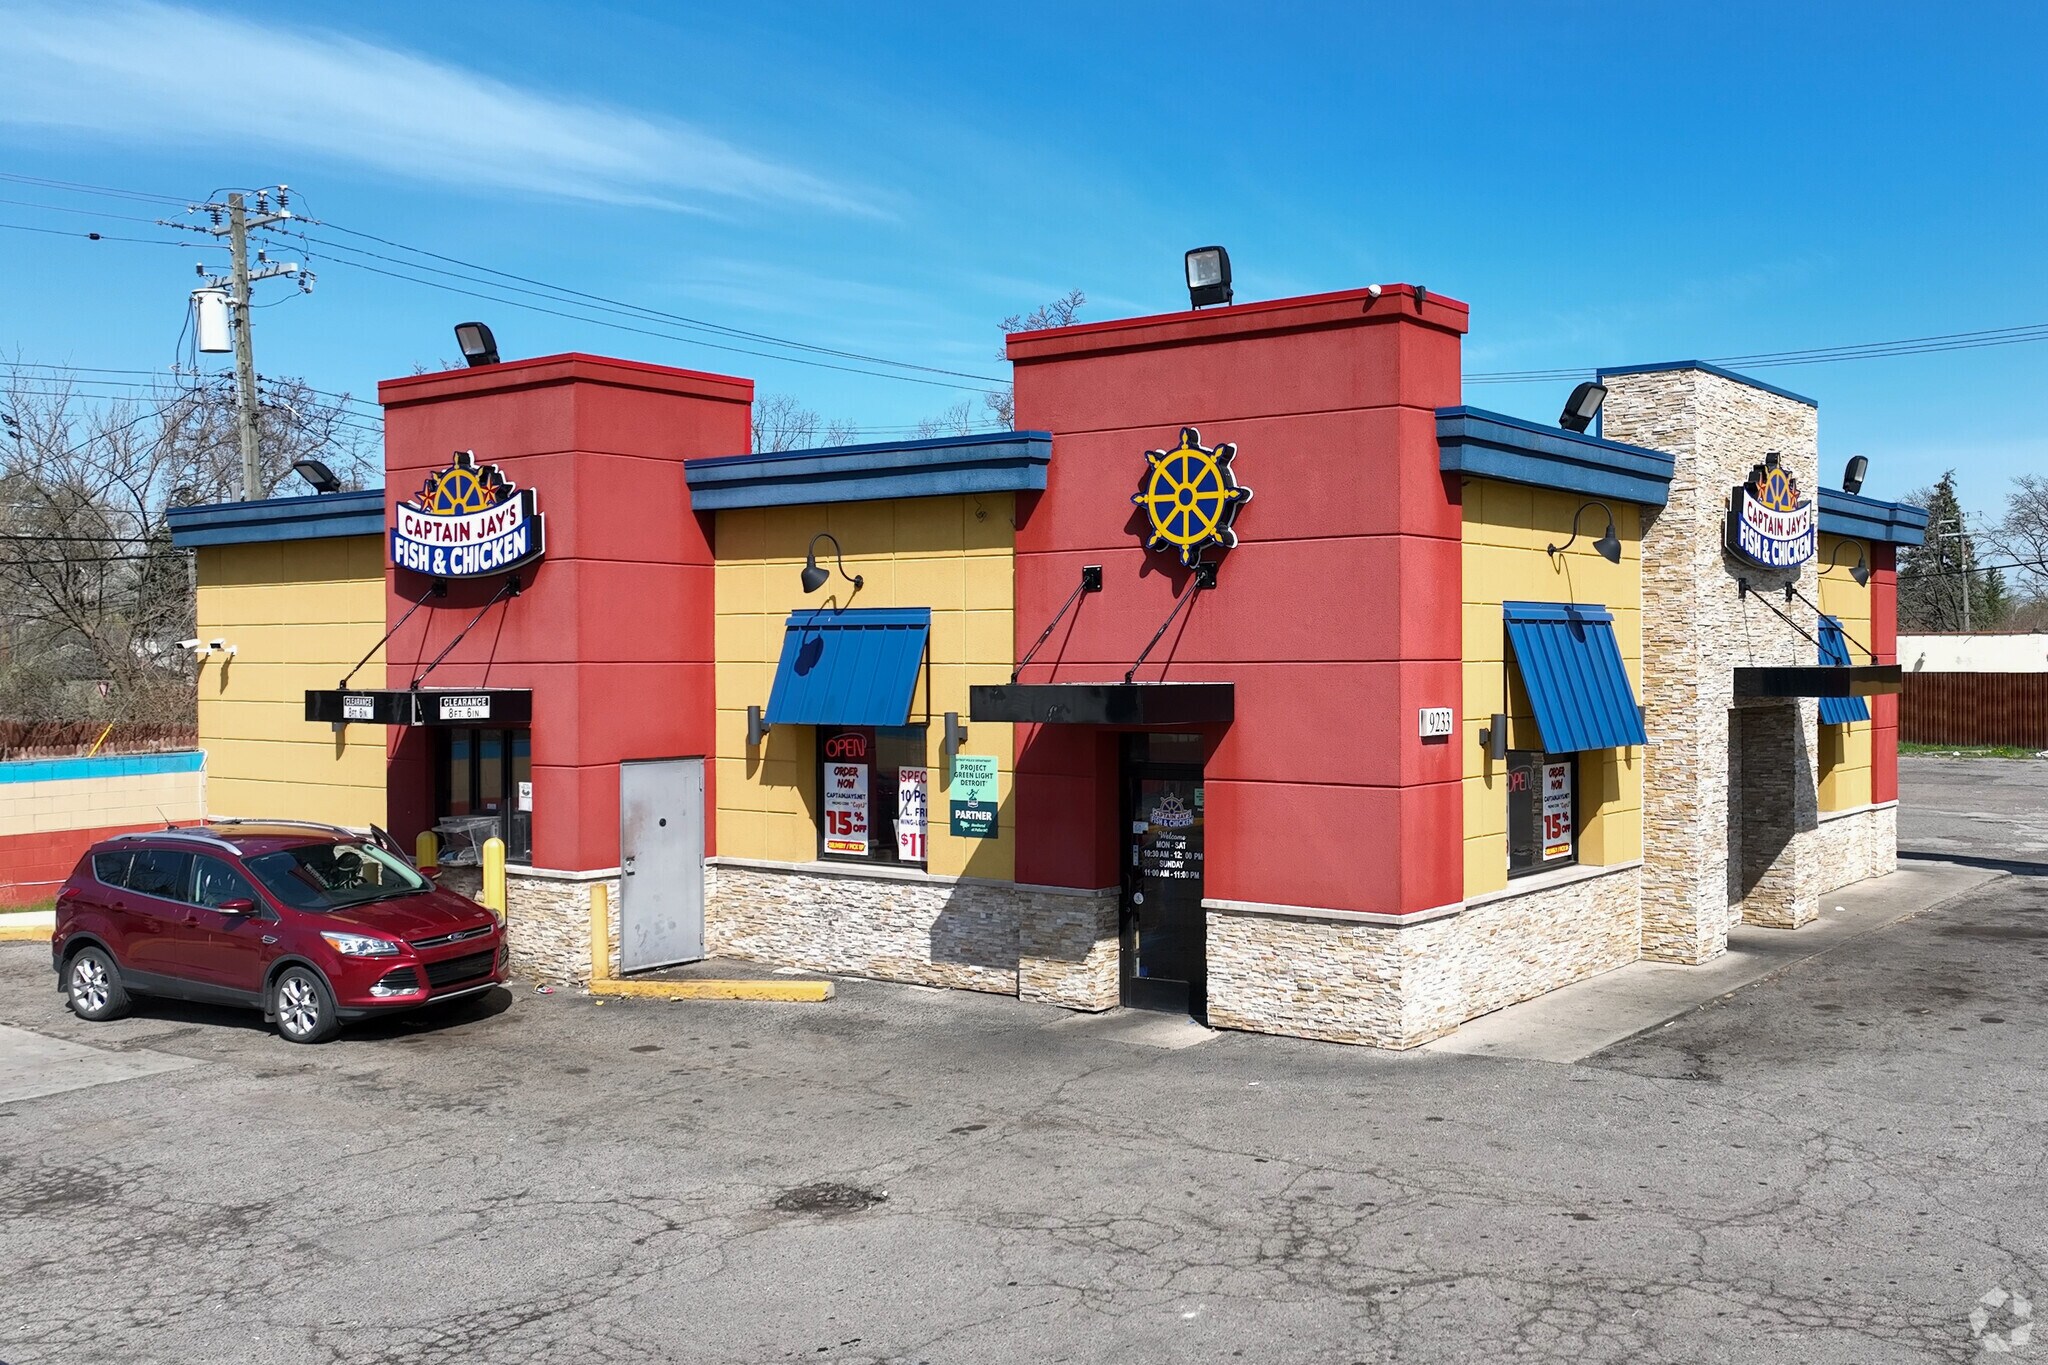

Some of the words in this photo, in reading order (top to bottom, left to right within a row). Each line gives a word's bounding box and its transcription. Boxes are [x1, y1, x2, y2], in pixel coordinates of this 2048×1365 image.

[405, 515, 470, 542] CAPTAIN
[477, 504, 516, 539] JAY'S
[1747, 501, 1783, 536] CAPTAIN
[1786, 511, 1807, 536] JAY'S
[1740, 519, 1761, 559] FISH
[1762, 538, 1771, 563] &
[1771, 532, 1811, 566] CHICKEN
[395, 536, 430, 572] FISH
[433, 548, 447, 574] &
[449, 526, 526, 575] CHICKEN
[443, 697, 486, 707] CLEARANCE
[1429, 711, 1450, 733] 9233
[826, 737, 866, 758] OPEN
[833, 766, 859, 778] ORDER
[960, 764, 987, 772] PROJECT
[1549, 766, 1565, 778] ORDER
[953, 771, 974, 779] GREEN
[975, 772, 993, 780] LIGHT
[837, 778, 855, 790] NOW
[960, 779, 986, 787] DETROIT
[1551, 779, 1563, 790] NOW
[901, 789, 911, 802] 10
[955, 810, 992, 821] PARTNER
[826, 810, 852, 835] 15
[854, 812, 864, 822] %
[1544, 813, 1561, 840] 15
[853, 824, 867, 833] OFF
[1562, 824, 1570, 833] OFF
[1158, 830, 1186, 841] Welcome
[1174, 841, 1186, 849] SAT
[1144, 850, 1159, 858] 10:30
[1194, 852, 1203, 860] PM
[1159, 860, 1184, 869] SUNDAY
